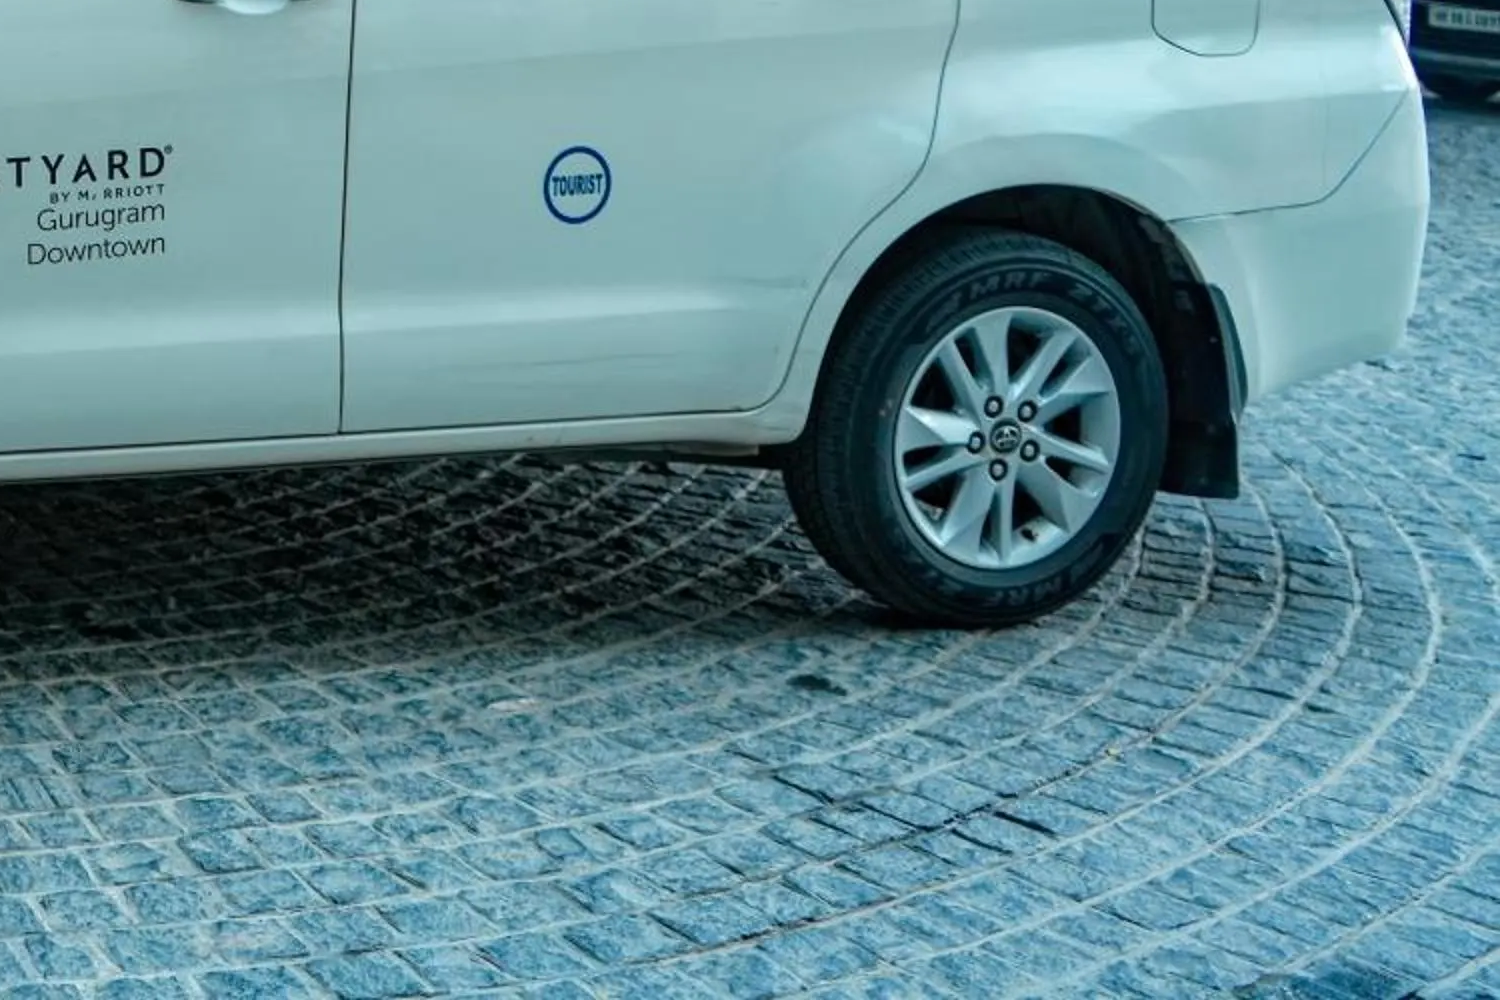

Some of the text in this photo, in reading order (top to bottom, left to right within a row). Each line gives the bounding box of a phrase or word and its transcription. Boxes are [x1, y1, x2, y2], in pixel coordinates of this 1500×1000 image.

[50, 192, 71, 204] BY
[551, 173, 603, 196] TOURIST
[37, 203, 165, 231] Gurugram
[27, 236, 165, 265] Downtown
[970, 271, 1051, 299] MRF
